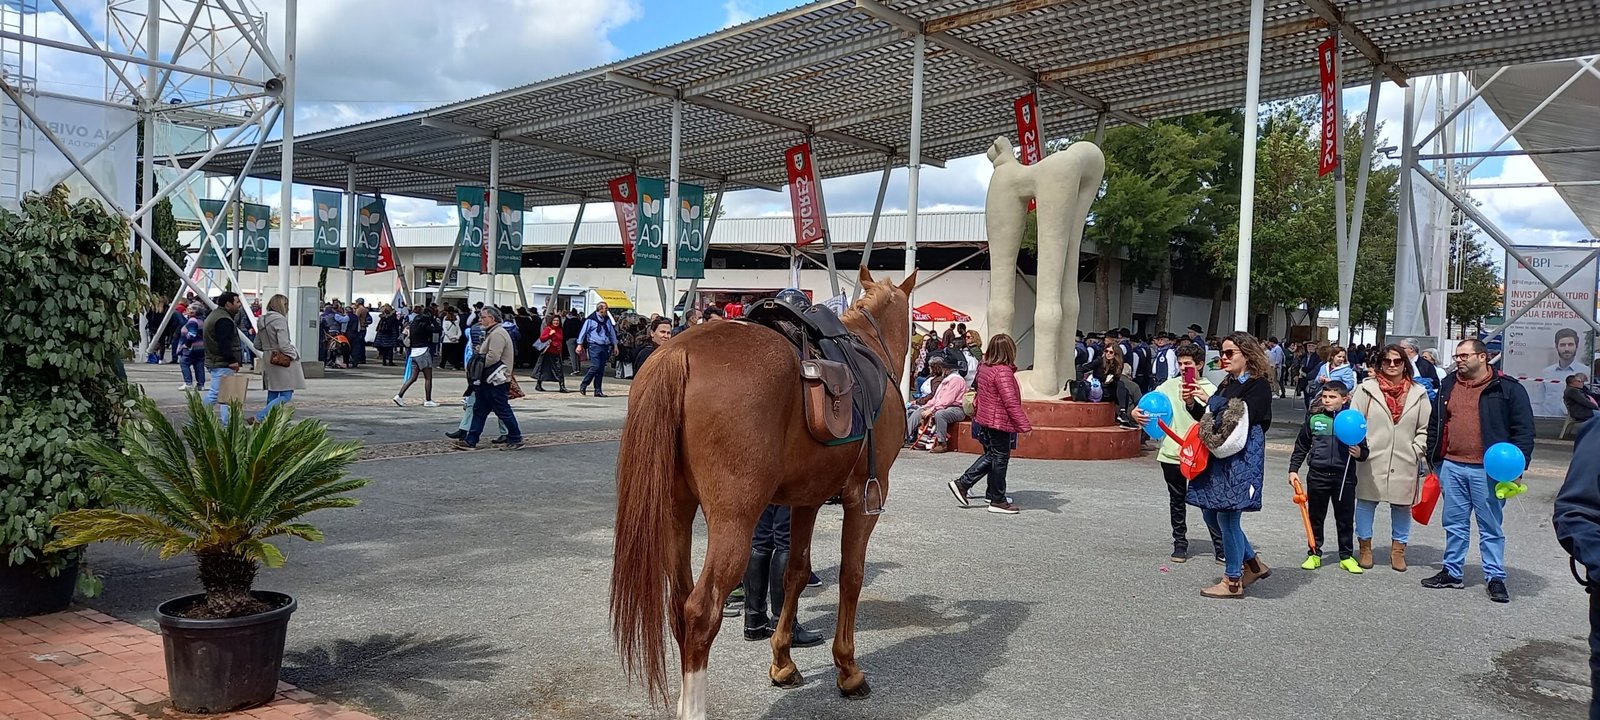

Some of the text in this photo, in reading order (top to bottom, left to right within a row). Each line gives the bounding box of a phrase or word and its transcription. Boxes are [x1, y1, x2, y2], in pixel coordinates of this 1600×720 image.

[1532, 257, 1551, 268] BPI
[1561, 291, 1589, 300] TURO
[1511, 300, 1566, 309] SUSNTÁVEL
